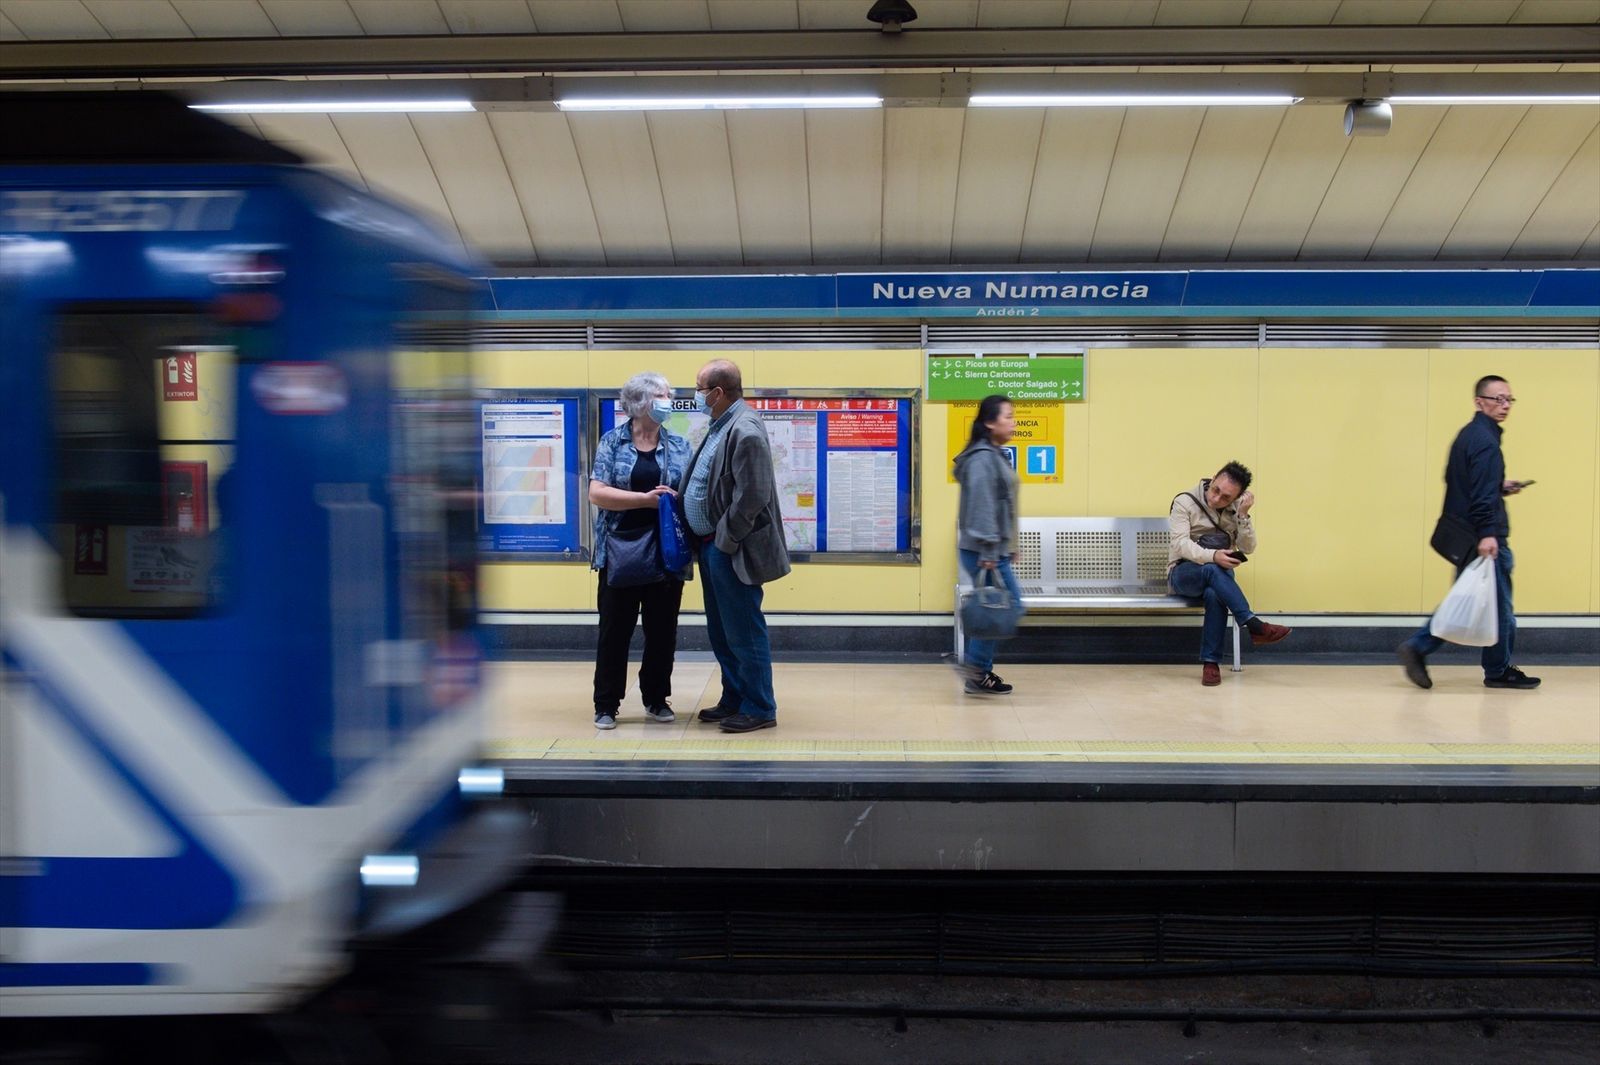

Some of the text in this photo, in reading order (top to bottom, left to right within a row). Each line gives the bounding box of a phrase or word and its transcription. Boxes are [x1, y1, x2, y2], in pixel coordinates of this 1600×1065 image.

[873, 281, 1149, 300] Nueva Numancia
[976, 307, 1040, 317] Andén 2
[954, 360, 1029, 369] C. Picos de Europa
[1026, 381, 1058, 389] Salgado
[1036, 448, 1047, 472] 1
